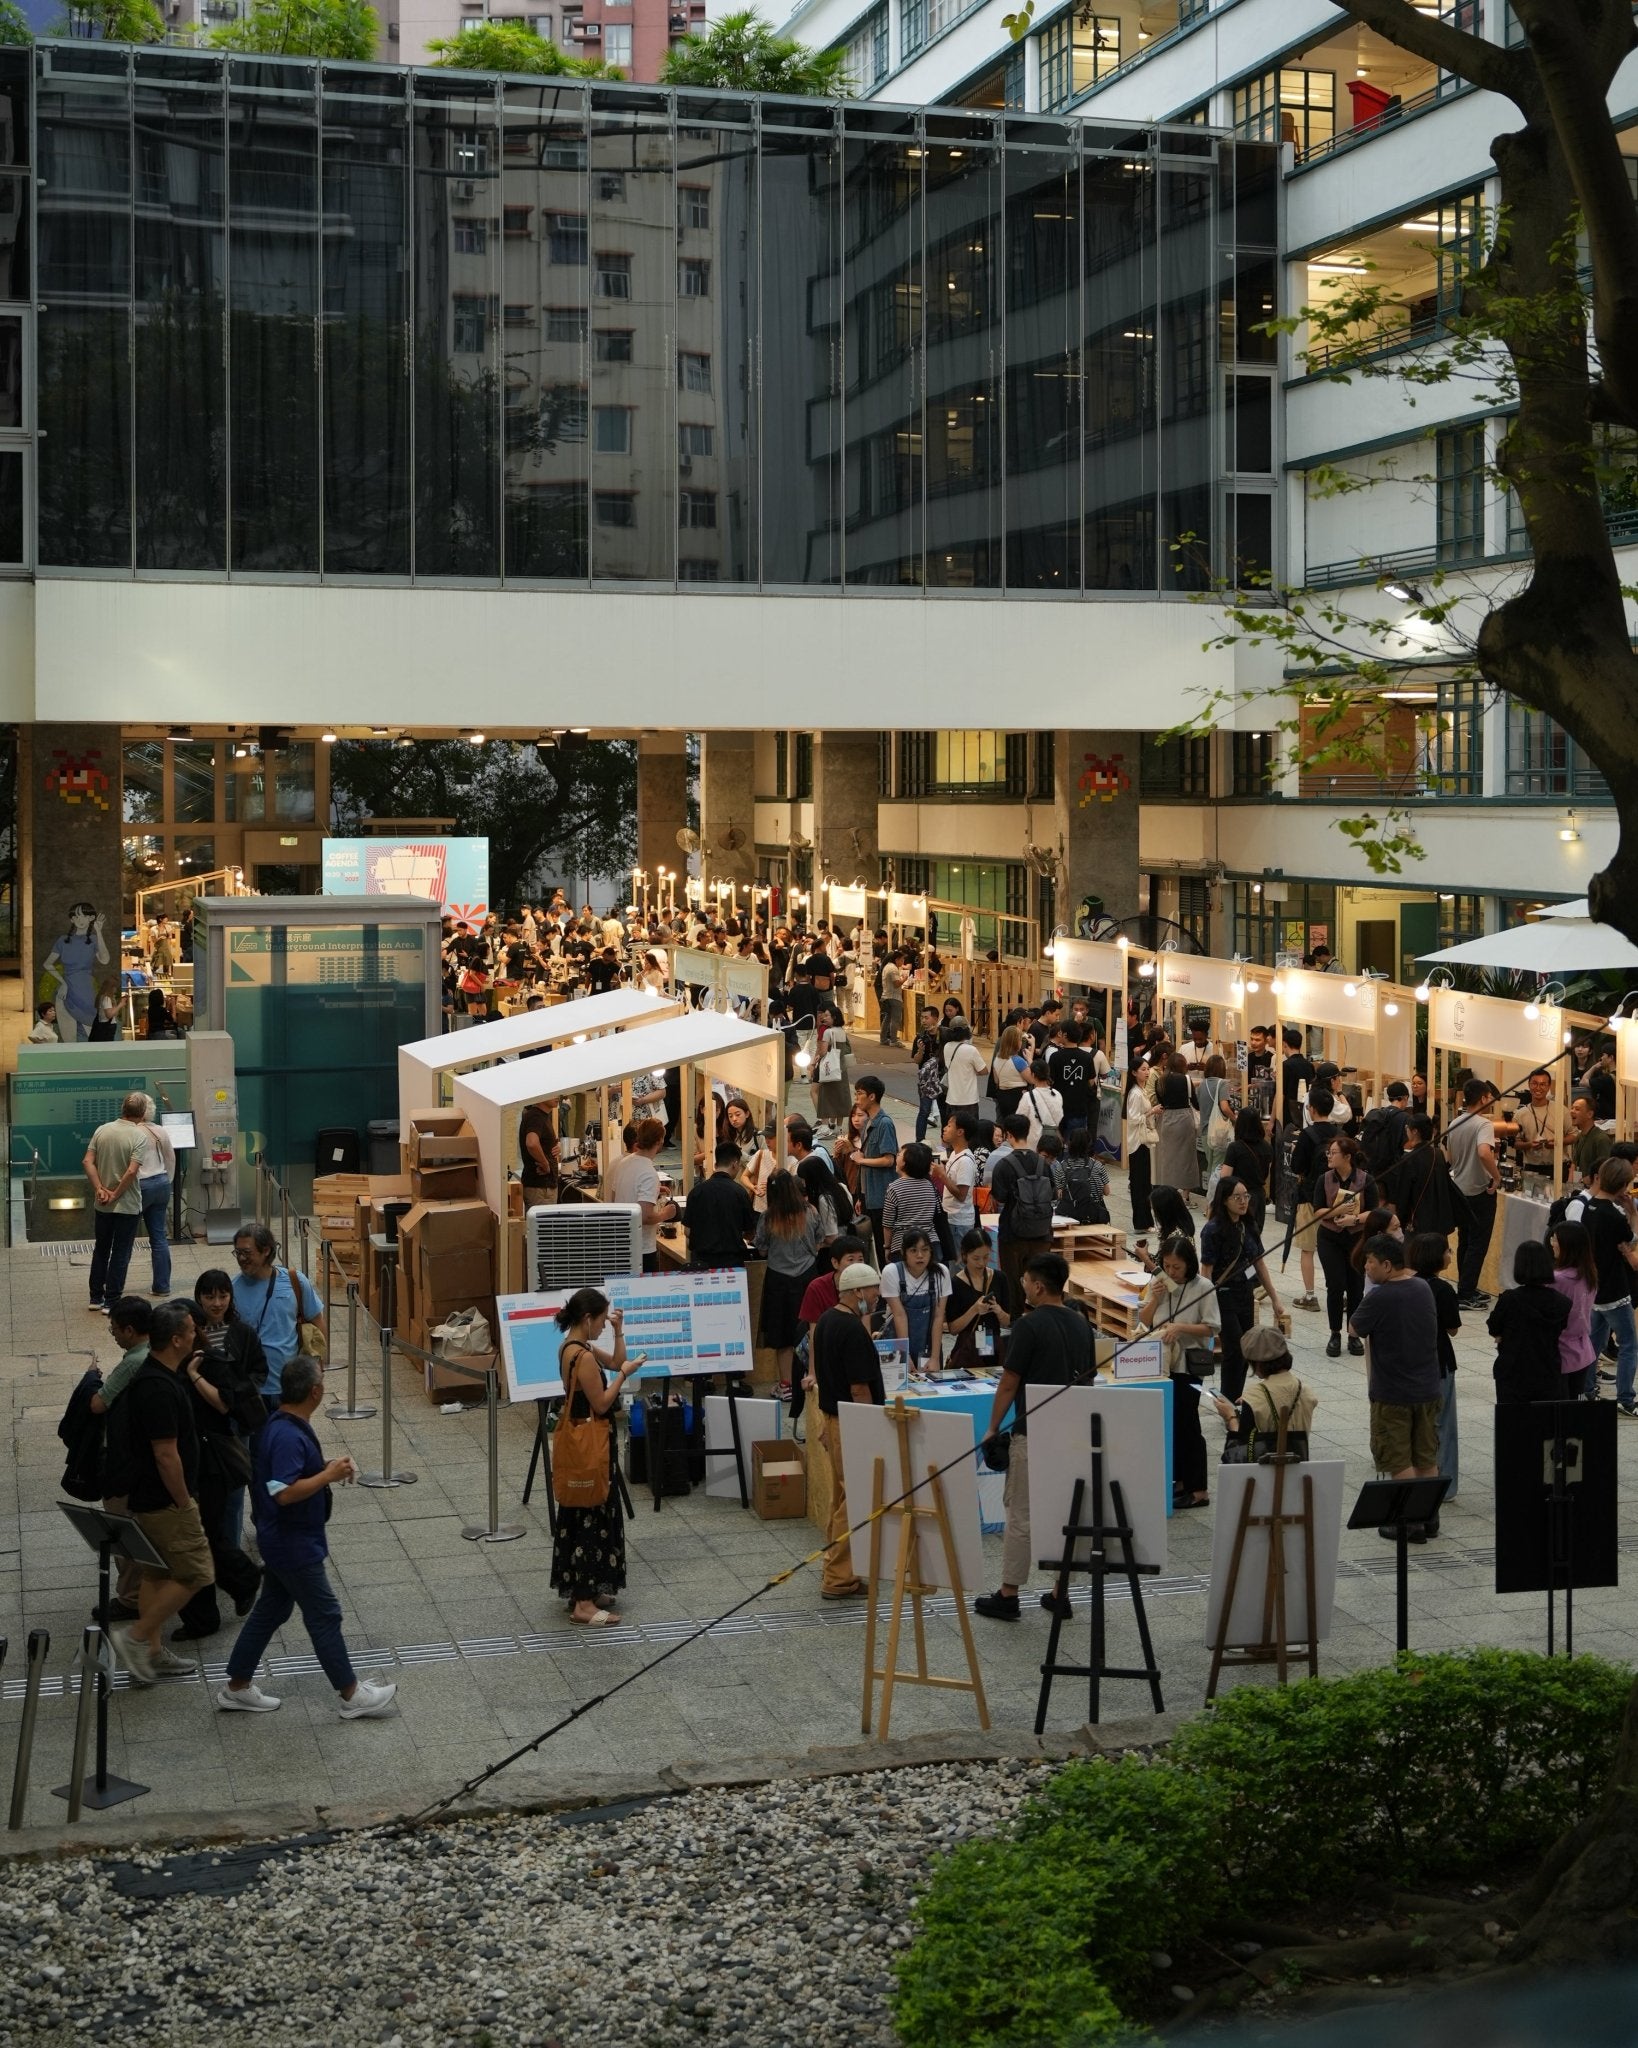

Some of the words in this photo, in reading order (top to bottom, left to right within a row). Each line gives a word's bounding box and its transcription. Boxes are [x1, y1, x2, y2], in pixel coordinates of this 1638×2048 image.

[265, 942, 326, 952] Underground
[328, 941, 392, 951] Interpretation
[394, 941, 416, 950] Area
[1119, 1355, 1157, 1364] Reception
